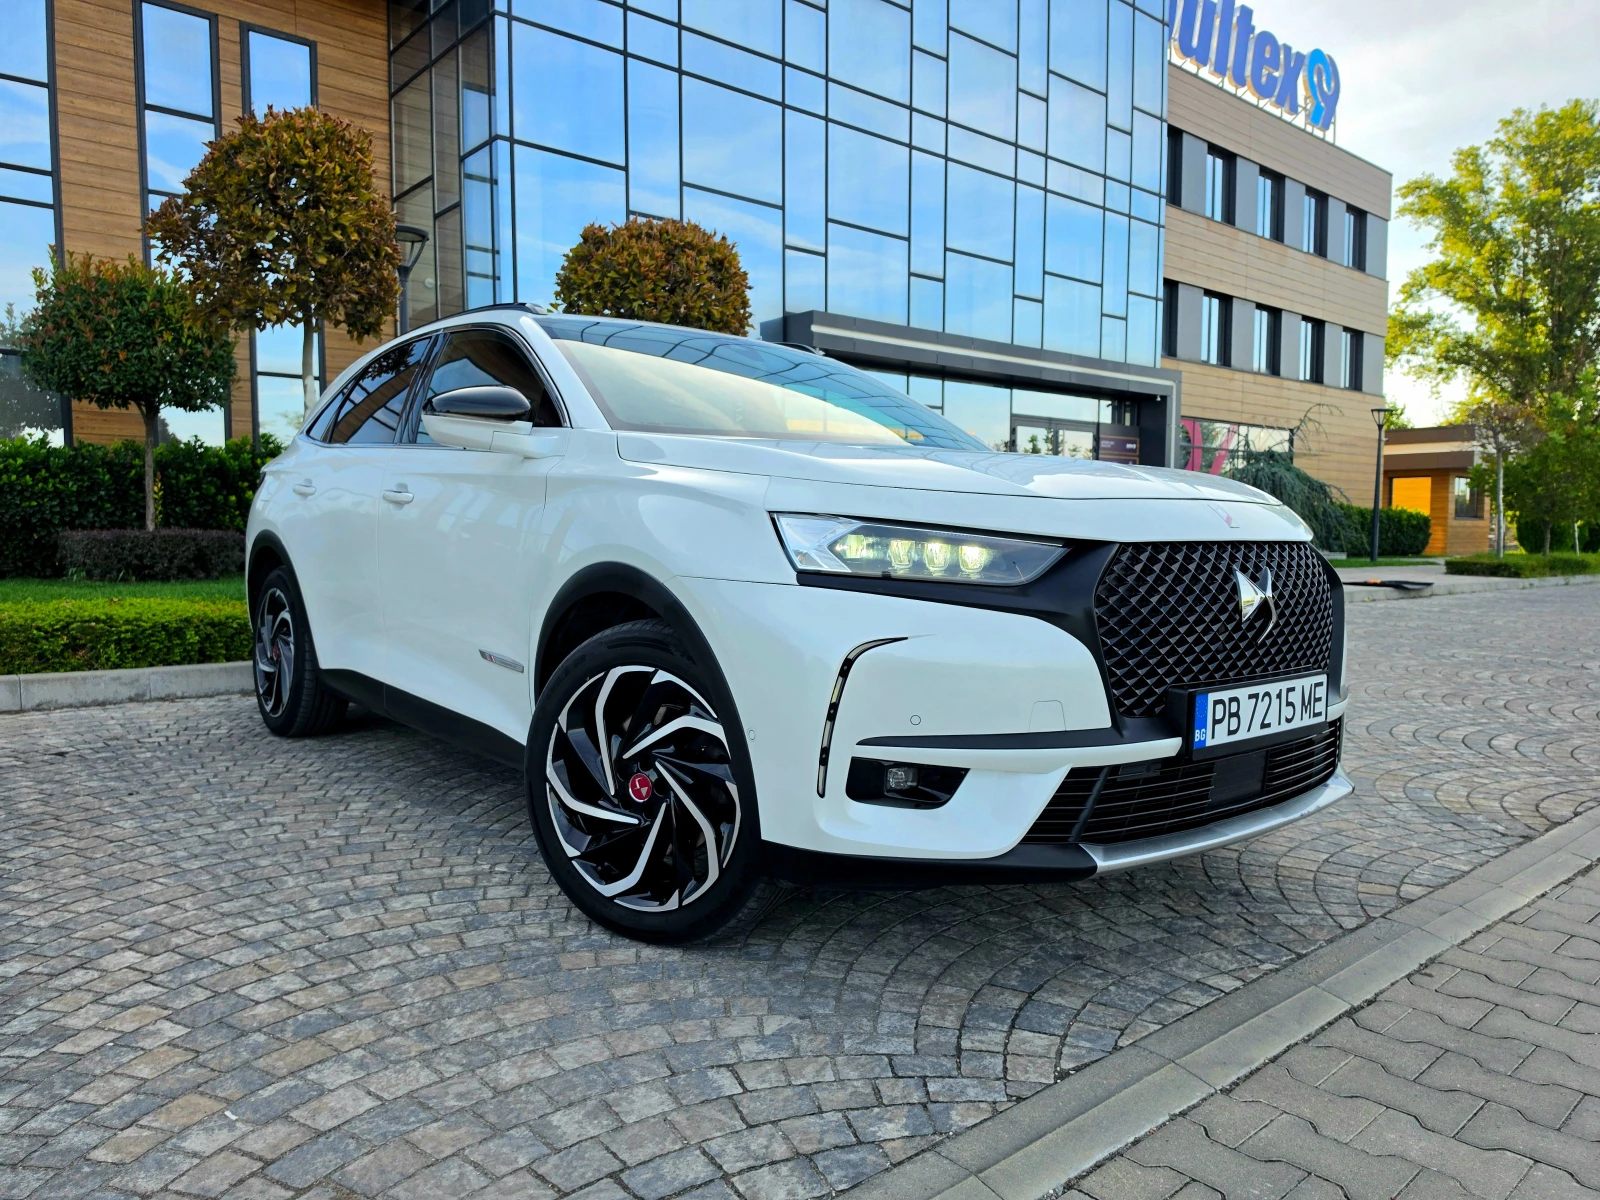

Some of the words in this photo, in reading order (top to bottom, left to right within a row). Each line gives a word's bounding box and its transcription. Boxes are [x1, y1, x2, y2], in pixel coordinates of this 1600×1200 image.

[1169, 0, 1306, 115] ultex
[1194, 728, 1206, 742] BG
[1211, 696, 1241, 740] PB
[1247, 686, 1296, 733] 7215
[1300, 681, 1324, 722] ME
